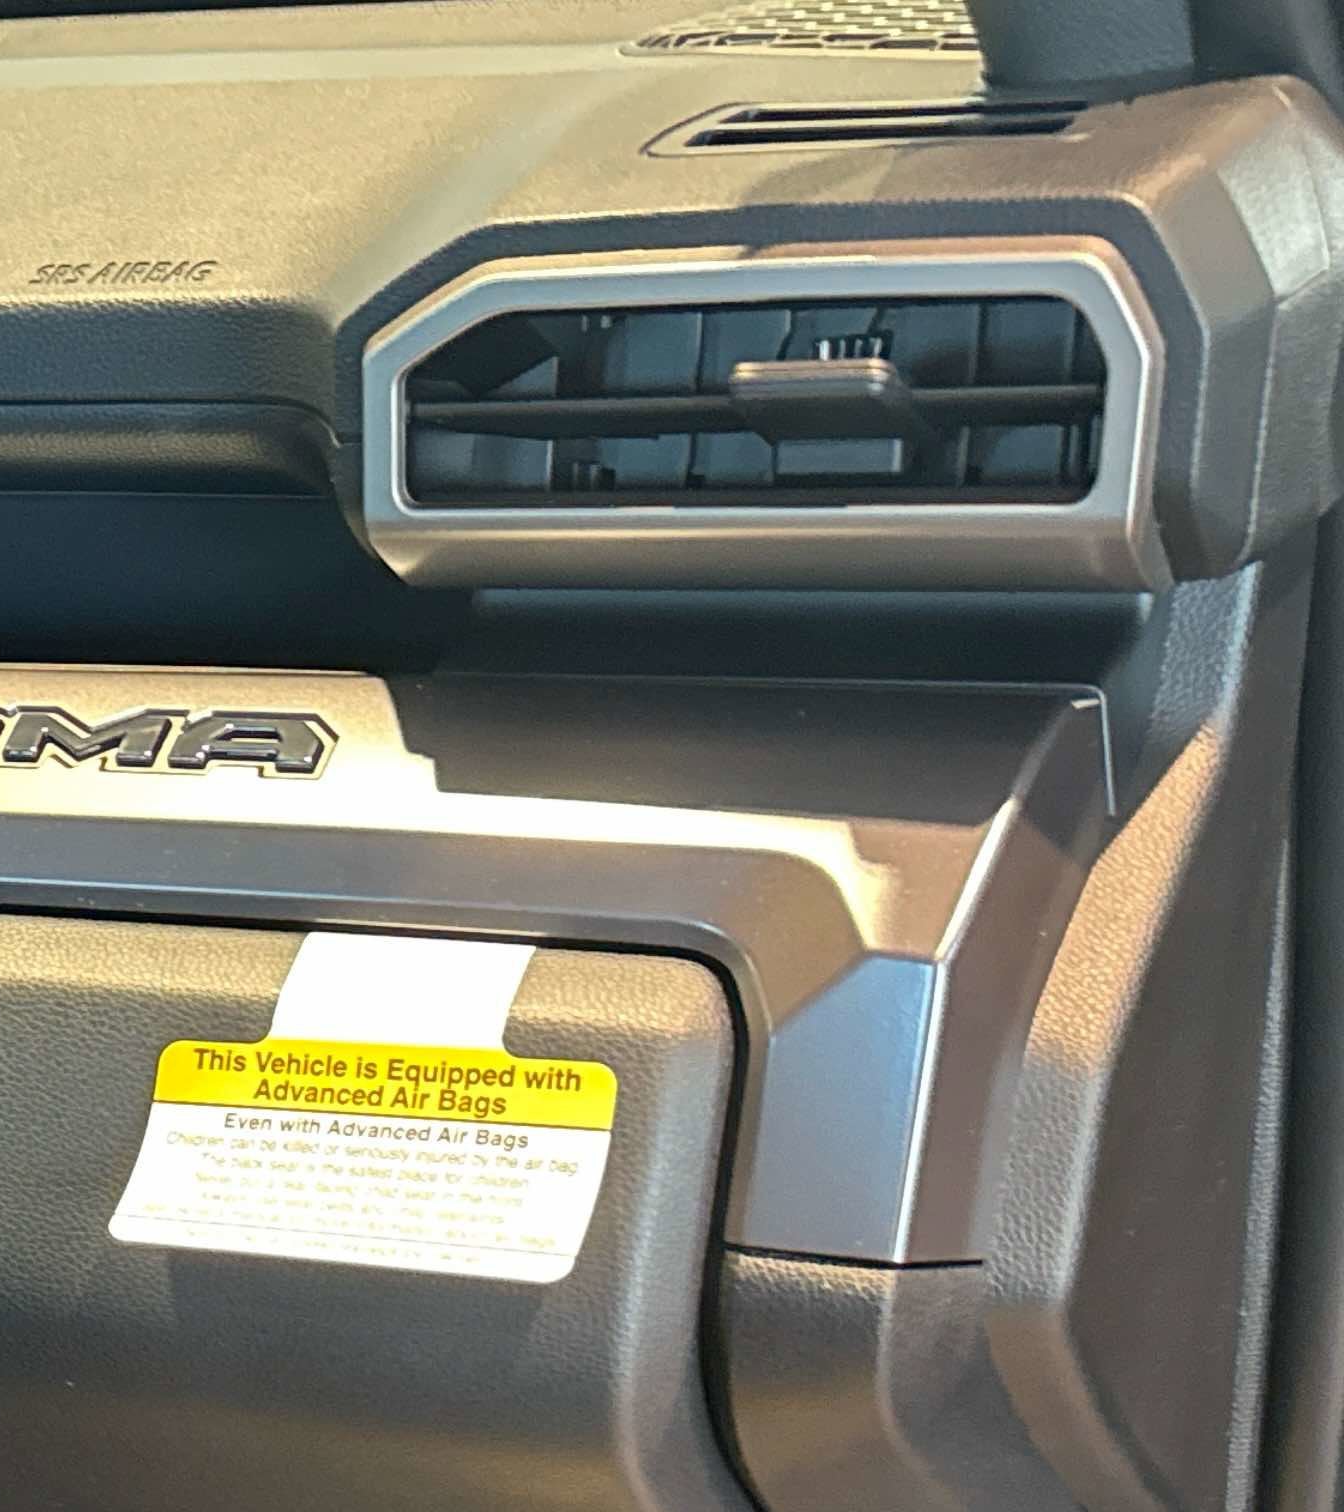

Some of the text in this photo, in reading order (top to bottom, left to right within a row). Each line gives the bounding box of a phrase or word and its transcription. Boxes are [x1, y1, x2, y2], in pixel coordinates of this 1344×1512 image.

[28, 260, 218, 285] SRS AIRBAG
[194, 1048, 582, 1091] This Vehicle is Equipped with
[253, 1078, 507, 1119] Advanced Air Bags
[224, 1112, 529, 1151] Even with Advanced Air Bags
